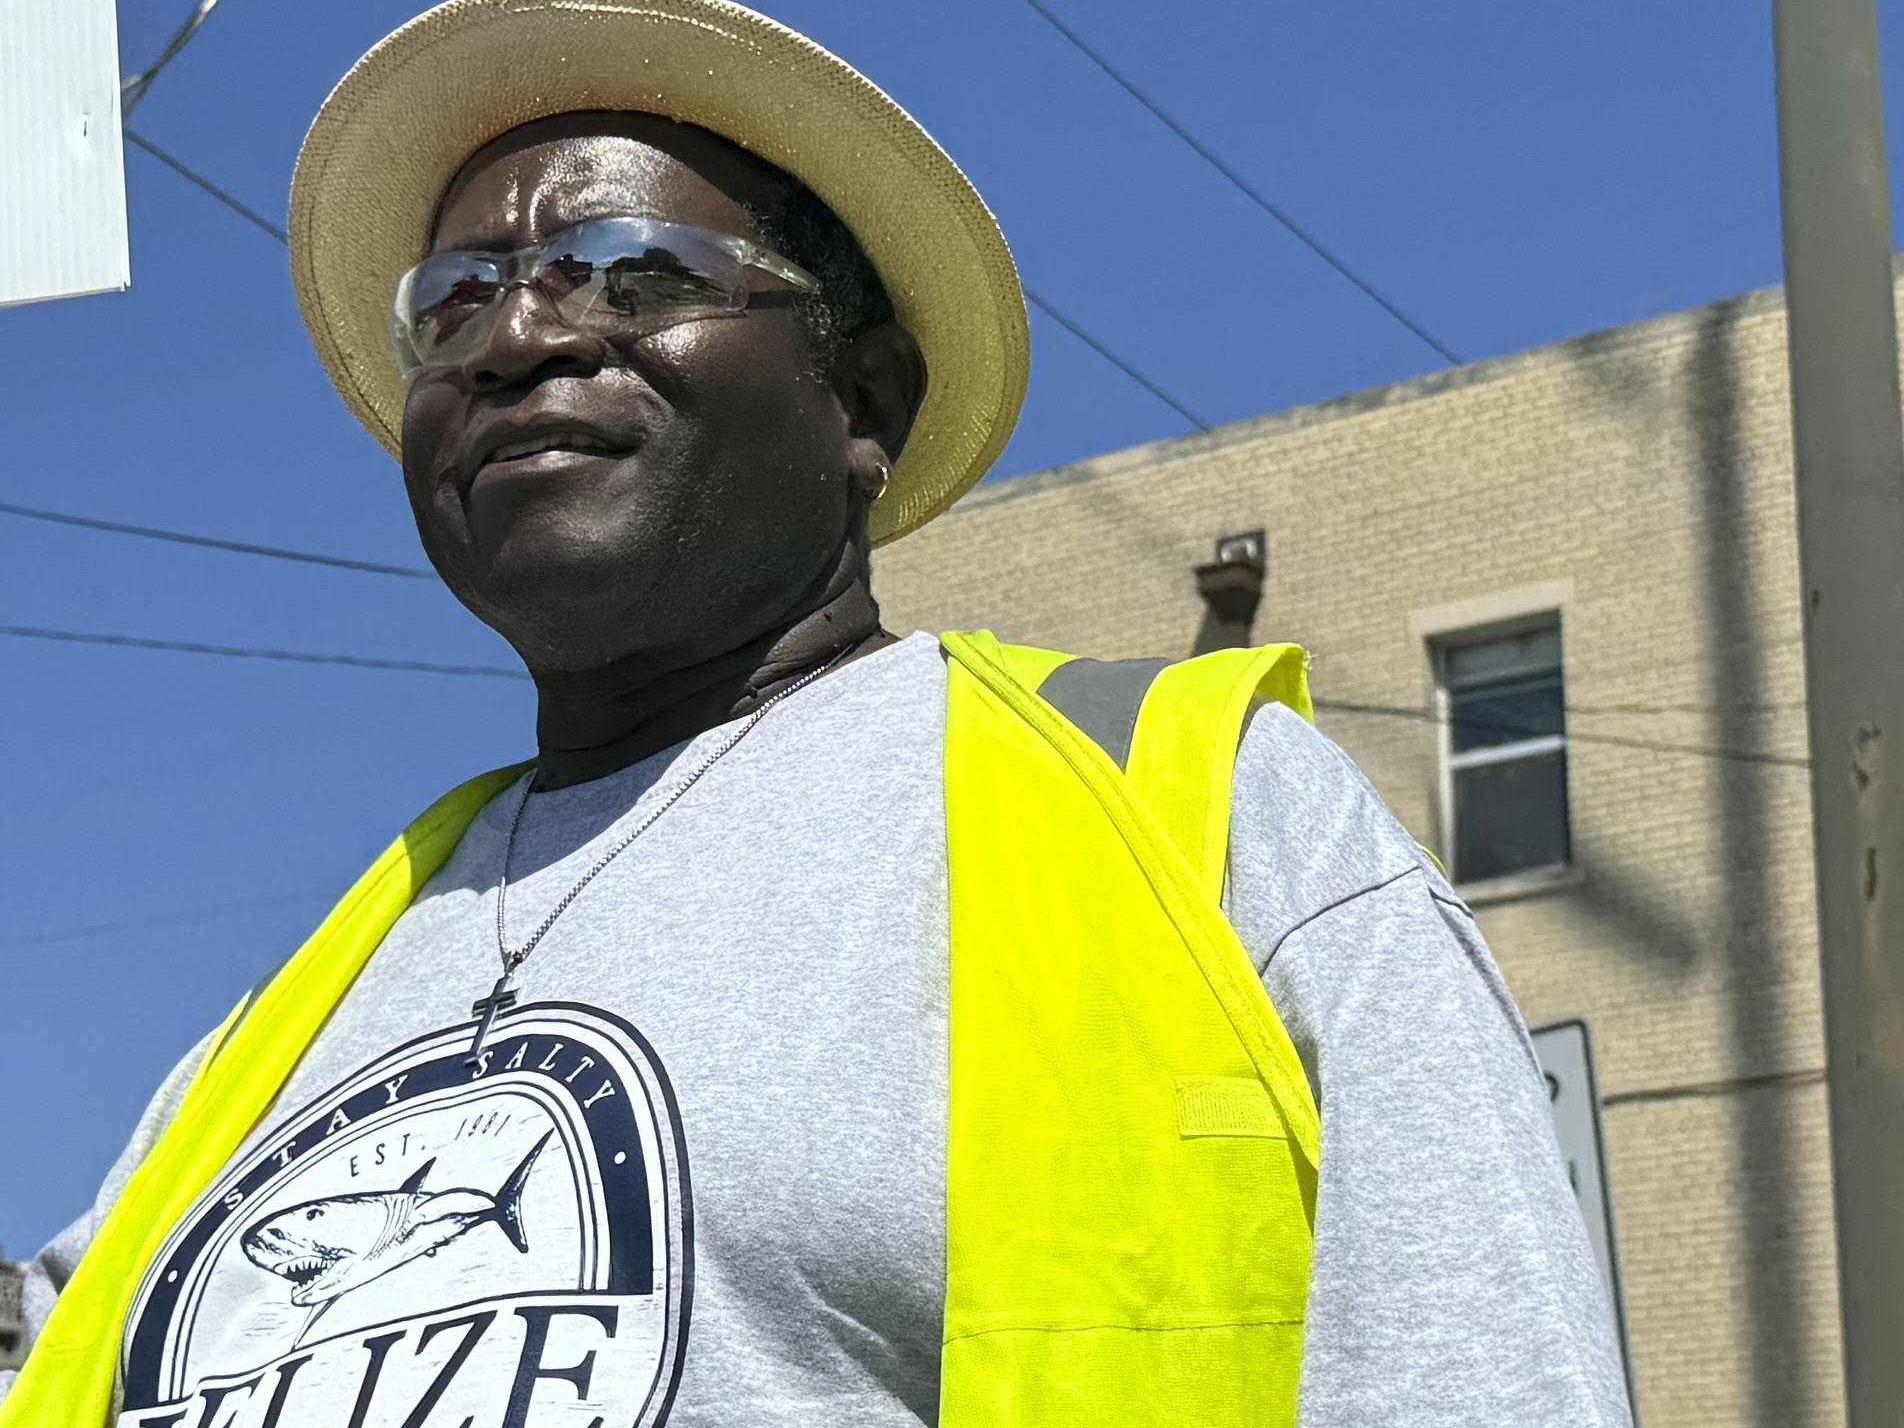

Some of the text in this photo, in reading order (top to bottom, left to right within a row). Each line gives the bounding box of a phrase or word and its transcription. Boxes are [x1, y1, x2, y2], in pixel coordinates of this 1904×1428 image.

[224, 1041, 616, 1211] STAY SALTY
[349, 1133, 426, 1178] EST.
